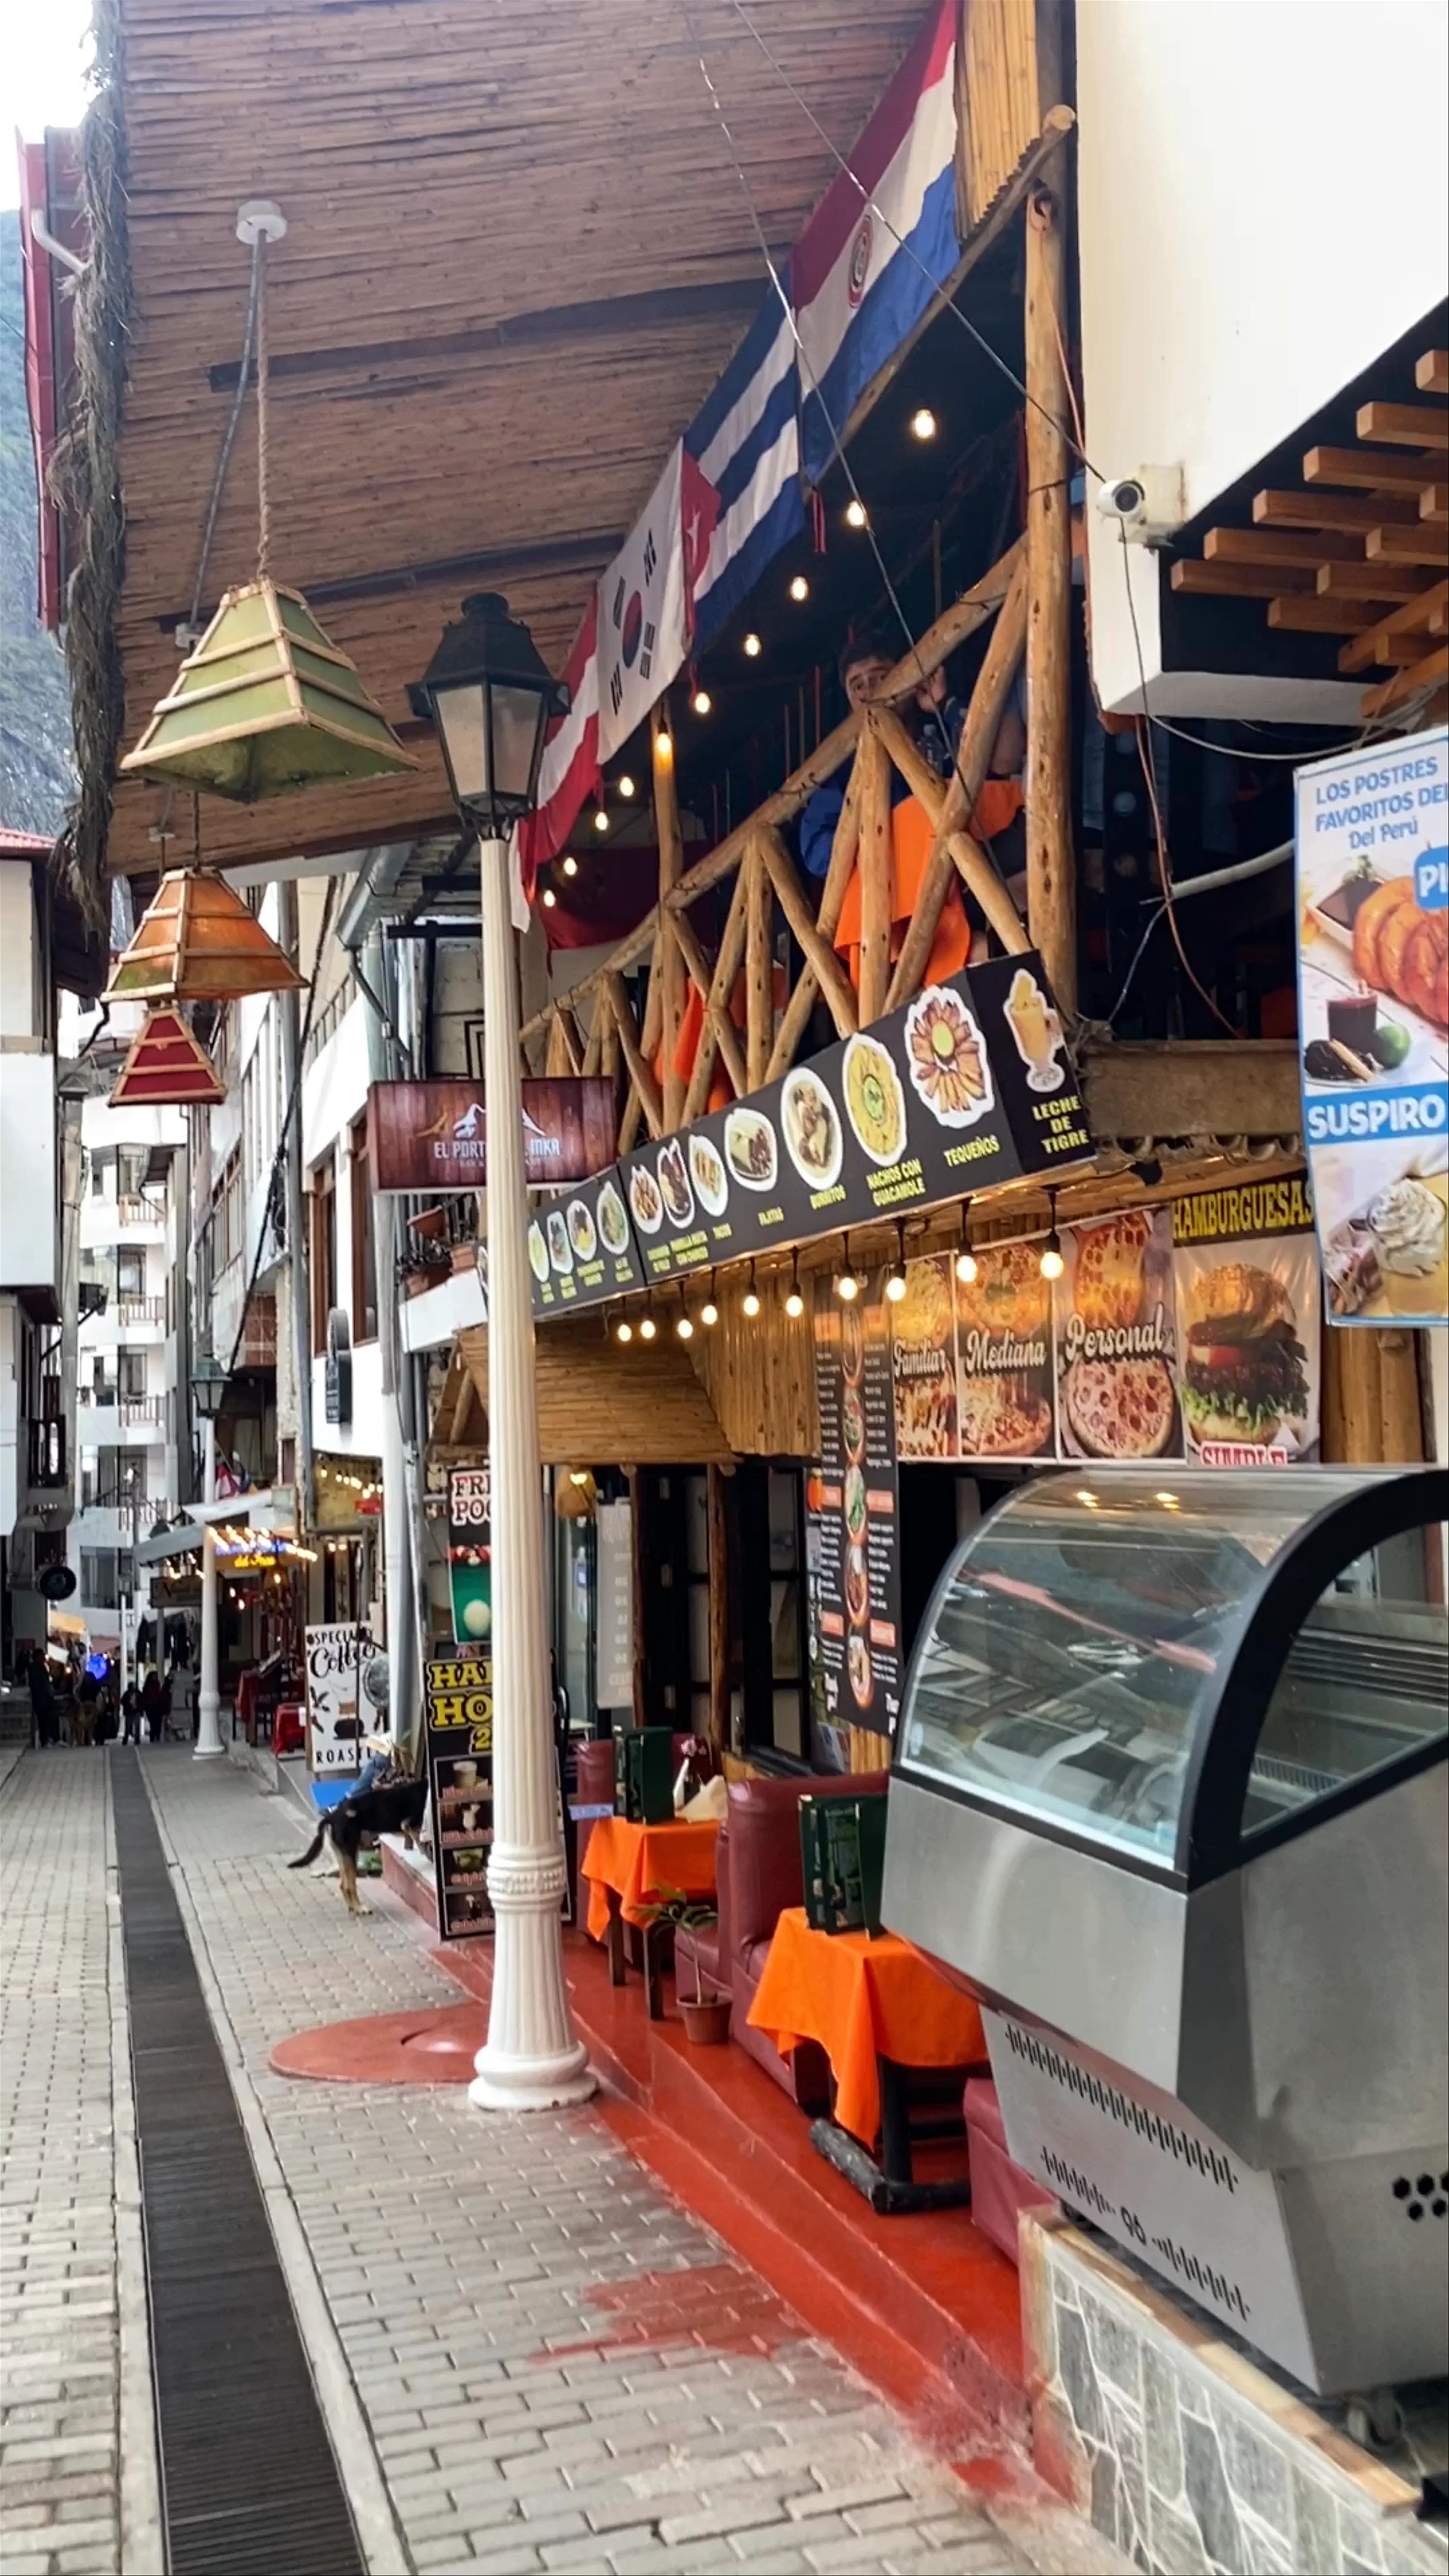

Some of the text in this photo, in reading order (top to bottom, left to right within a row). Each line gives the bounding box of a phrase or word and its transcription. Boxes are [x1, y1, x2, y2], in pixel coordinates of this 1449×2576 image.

[1315, 756, 1439, 805] LOS POSTRES
[1315, 790, 1414, 832] FAVORITOS
[1349, 814, 1418, 850] Del Perú
[1032, 1096, 1082, 1121] LECHE
[1050, 1115, 1072, 1134] DE
[1308, 1093, 1446, 1139] SUSPIRO
[434, 1140, 487, 1159] EL PORT
[944, 1134, 1000, 1167] TEQUEÑOS
[1041, 1129, 1090, 1154] TIGRE
[866, 1157, 923, 1190] NACHOS CON
[872, 1176, 926, 1206] GUACAMOLE
[1065, 1303, 1165, 1362] Personal
[894, 1338, 946, 1378] Familiar
[966, 1328, 1046, 1373] Mediana
[454, 1475, 491, 1497] FR
[454, 1497, 491, 1521] PO
[433, 1693, 493, 1726] HO
